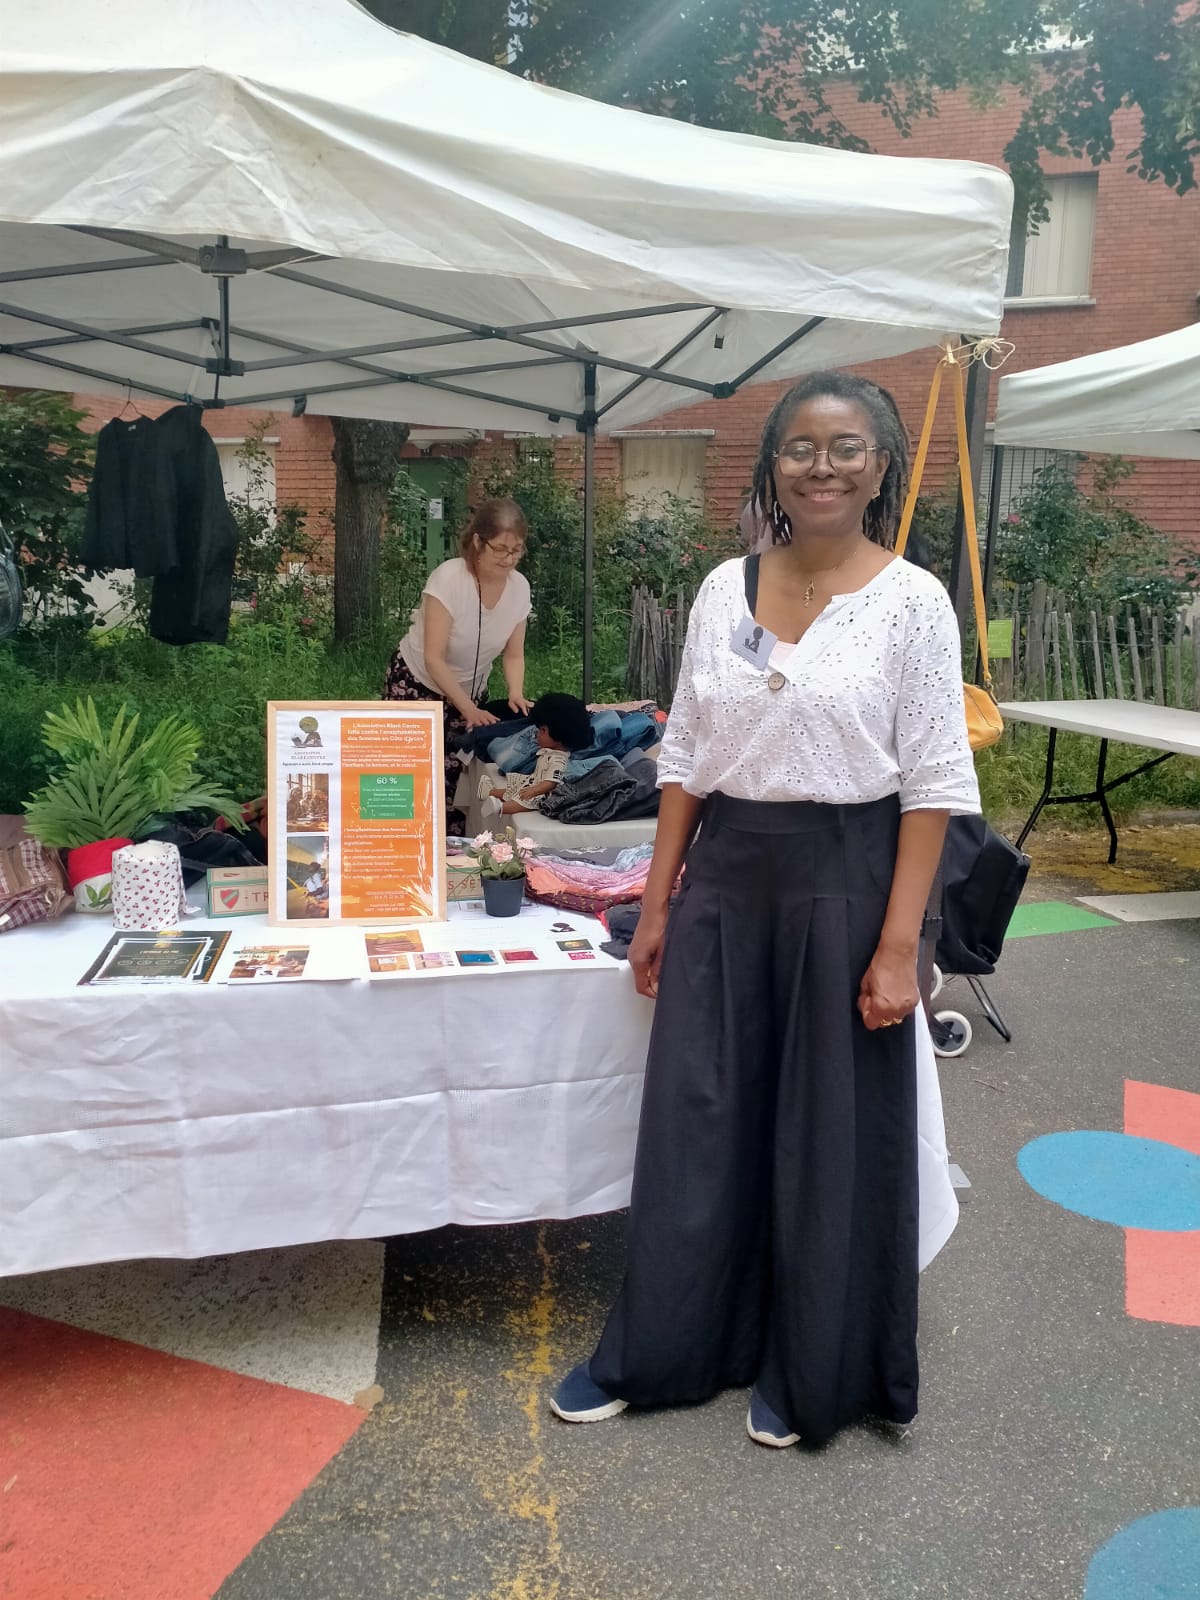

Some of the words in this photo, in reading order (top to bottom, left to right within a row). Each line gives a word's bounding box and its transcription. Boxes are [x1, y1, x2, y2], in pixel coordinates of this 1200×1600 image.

[376, 777, 388, 785] 60
[389, 777, 398, 785] %
[251, 891, 269, 902] TR
